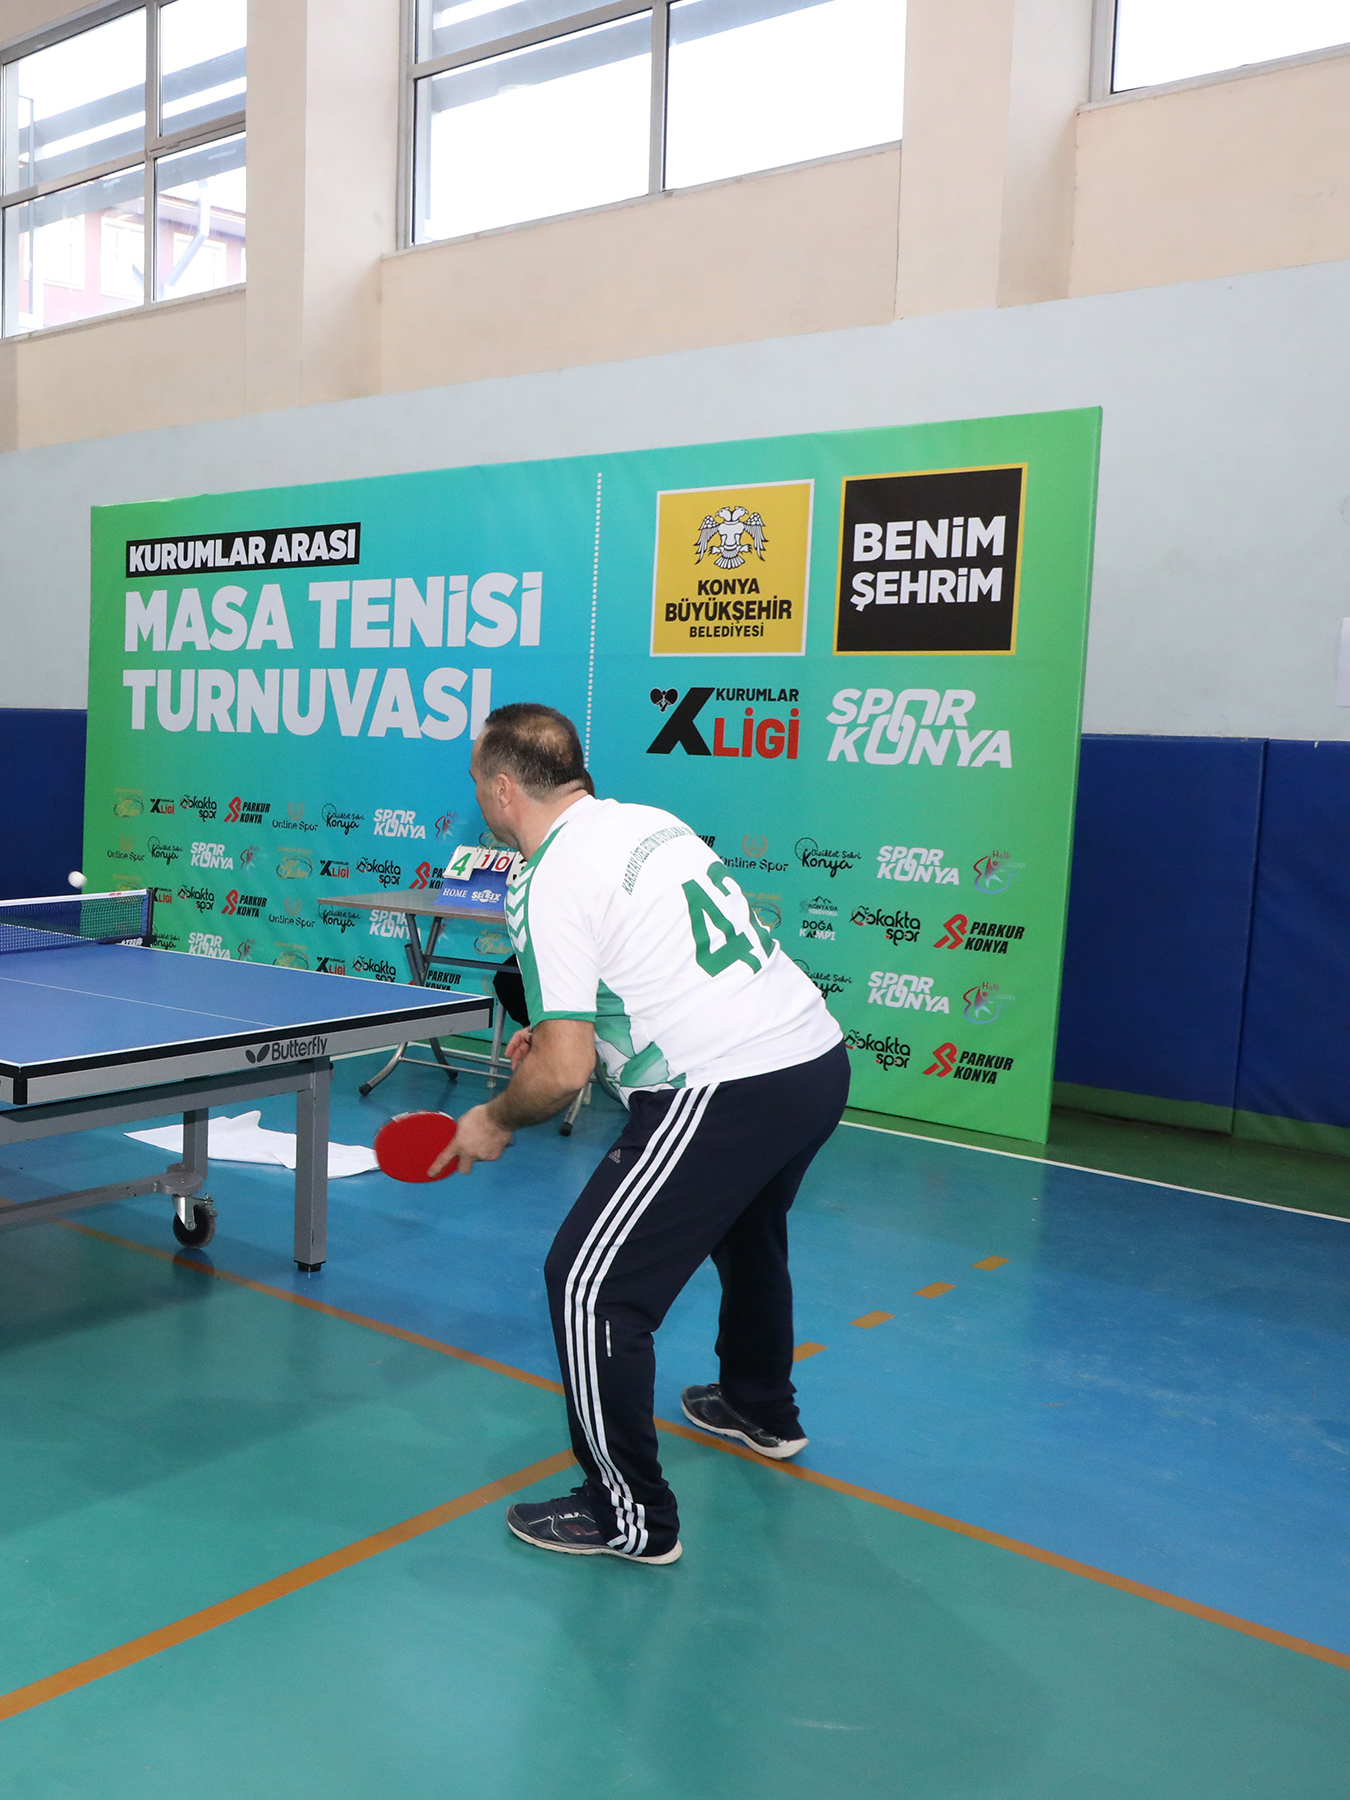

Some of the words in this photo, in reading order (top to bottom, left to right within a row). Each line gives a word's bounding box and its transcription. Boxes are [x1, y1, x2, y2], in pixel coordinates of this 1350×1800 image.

[129, 536, 266, 573] KURUMLAR
[270, 529, 356, 563] ARASI
[697, 577, 760, 596] KONYA
[124, 583, 293, 652] MASA
[665, 596, 792, 625] BÜYÜKŞEHİR
[689, 622, 764, 638] BELEDİYESİ
[123, 668, 492, 740] TURNUVASI
[716, 687, 799, 702] KURUMLAR
[826, 688, 976, 727] SPOR
[827, 713, 1012, 768] KONYA
[242, 801, 271, 813] PARKUR
[373, 808, 416, 824] SPOR
[239, 813, 263, 824] KONYA
[326, 812, 359, 835] Konya
[373, 817, 426, 839] KONYA
[190, 841, 225, 856] SPOR
[877, 845, 944, 866] SPOR
[190, 850, 234, 870] KONYA
[451, 853, 472, 876] 4
[759, 859, 789, 873] Spor
[801, 848, 853, 878] Konya
[378, 874, 401, 888] spor
[622, 857, 642, 896] KARATAY
[877, 859, 960, 885] KONYA
[239, 894, 267, 907] PARKUR
[443, 888, 468, 898] HOME
[236, 907, 260, 918] KONYA
[803, 920, 833, 932] DOĞA
[970, 921, 1025, 940] PARKUR
[188, 932, 223, 948] SPOR
[885, 928, 920, 946] spor
[964, 937, 1009, 954] KONYA
[427, 970, 461, 985] PARKUR
[867, 970, 934, 994] SPOR
[867, 984, 950, 1014] KONYA
[272, 1036, 328, 1061] Butterfly
[874, 1052, 909, 1071] spor
[959, 1050, 1015, 1071] PARKUR
[953, 1066, 998, 1085] KONYA
